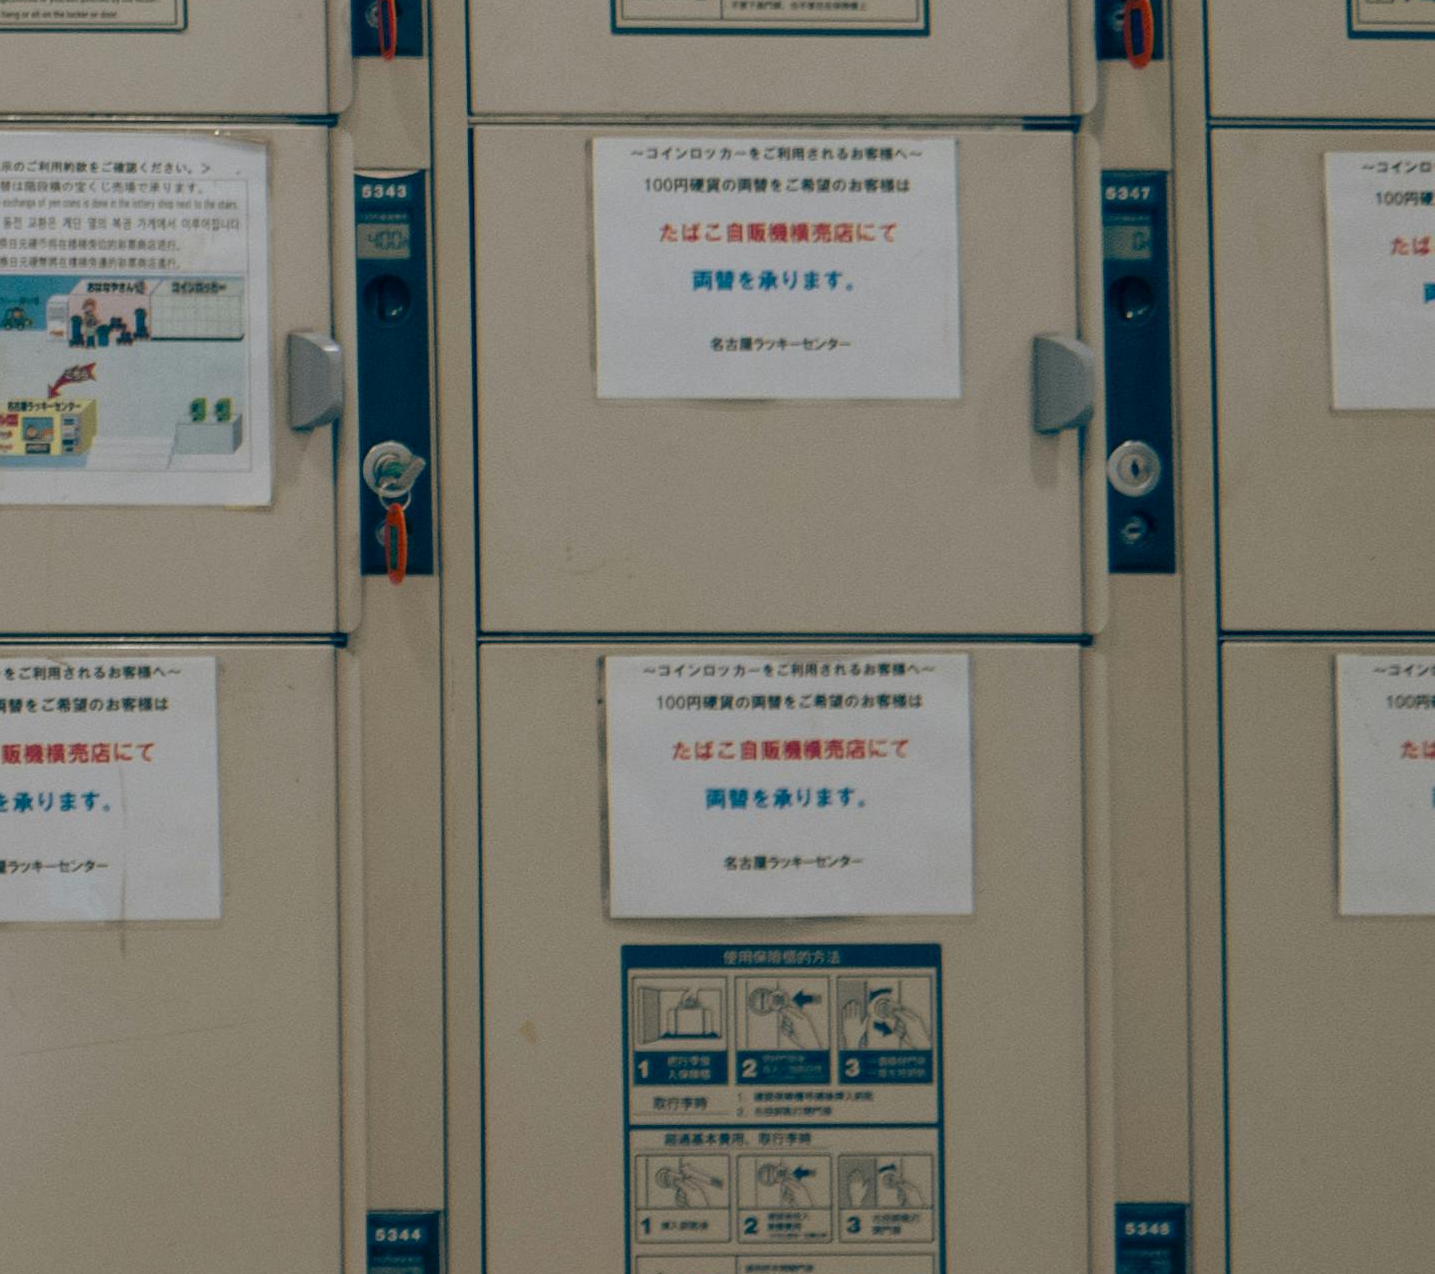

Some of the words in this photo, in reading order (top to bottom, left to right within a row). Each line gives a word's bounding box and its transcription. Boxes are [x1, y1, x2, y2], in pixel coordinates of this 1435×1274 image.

[362, 186, 406, 198] 5343
[1106, 187, 1149, 200] 5347
[660, 221, 898, 244] たばこ自販機横売店にて
[657, 692, 924, 711] 100円硬貨の両替をご希望のお客様は
[672, 738, 910, 762] たばこ自販機横売店にて
[704, 786, 865, 811] 両替を承ります。
[376, 1229, 420, 1241] 5344
